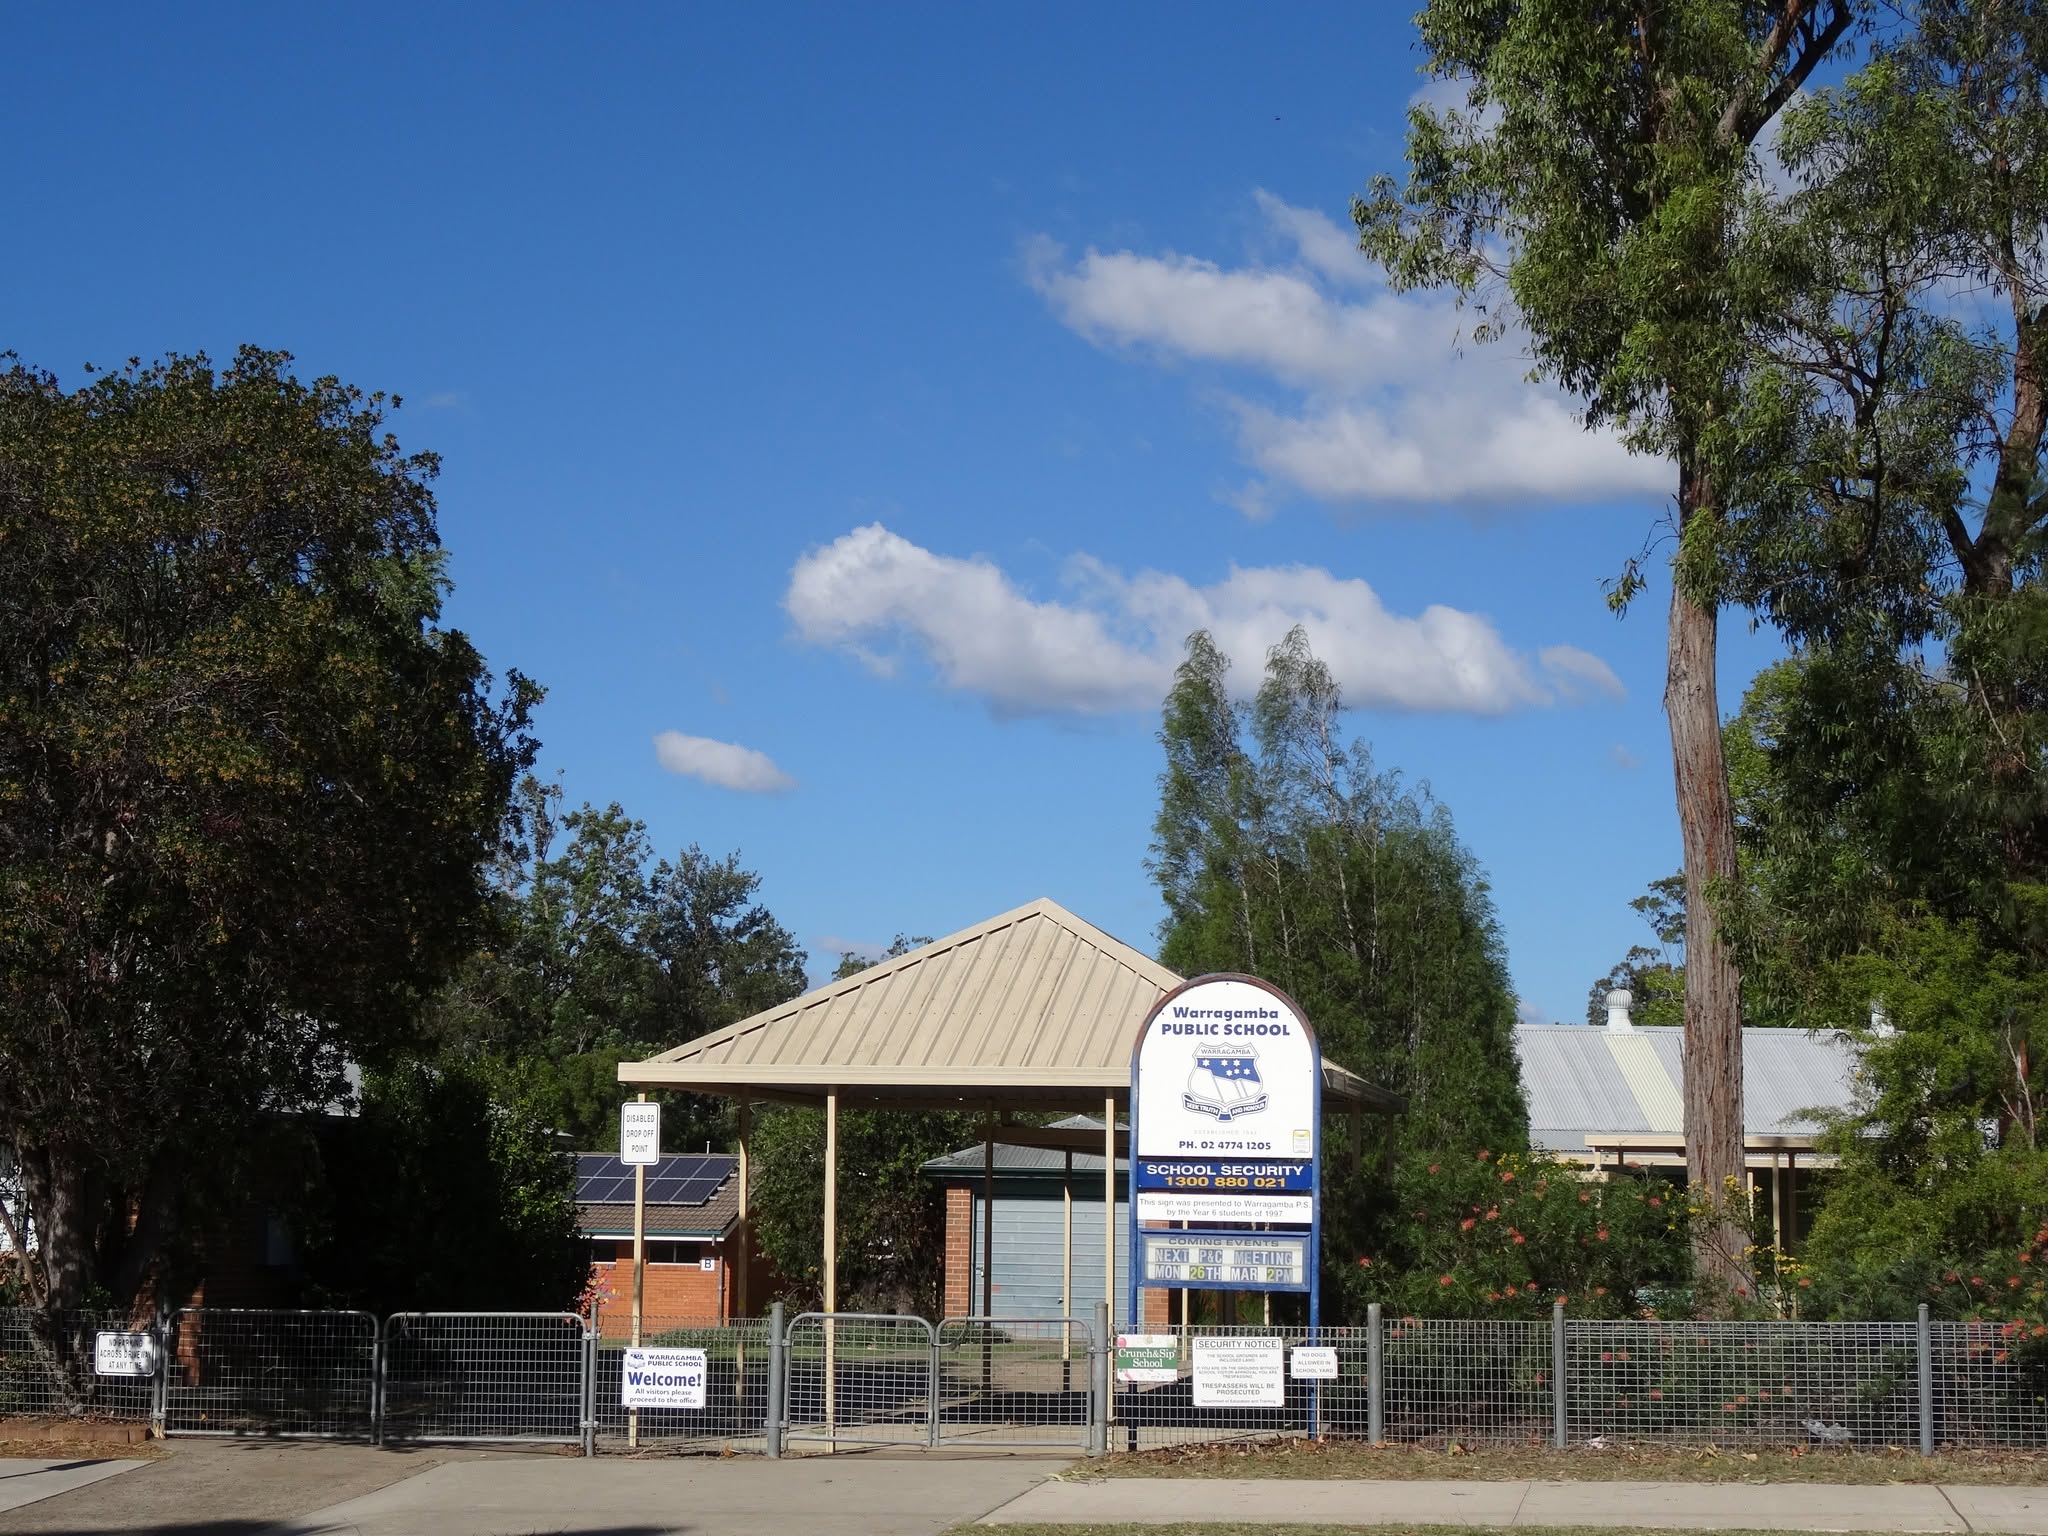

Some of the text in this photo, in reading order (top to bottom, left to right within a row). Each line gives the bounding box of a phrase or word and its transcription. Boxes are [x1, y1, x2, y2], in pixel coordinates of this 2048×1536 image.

[1173, 1007, 1278, 1021] Warragamba
[1162, 1024, 1290, 1036] PUBLIC SCHOOL
[1200, 1106, 1218, 1114] TRUTH
[1244, 1103, 1264, 1112] HONOUR
[626, 1115, 655, 1123] DISABLED
[626, 1130, 642, 1138] DROP
[1179, 1141, 1197, 1149] PH.
[1247, 1141, 1271, 1150] 1205
[1146, 1165, 1304, 1176] SCHOOL SECURITY
[1164, 1176, 1286, 1187] 1300 880 021
[1193, 1200, 1232, 1209] presented
[1244, 1201, 1294, 1209] Warragamba
[1155, 1249, 1292, 1265] NEXT P&C MEETING
[705, 1259, 711, 1268] B
[1155, 1265, 1180, 1279] MON
[1190, 1266, 1222, 1280] 26TH
[1231, 1267, 1258, 1281] MAR
[1119, 1348, 1175, 1360] Crunch&Sip
[1133, 1359, 1162, 1367] School
[628, 1372, 701, 1387] Welcome!
